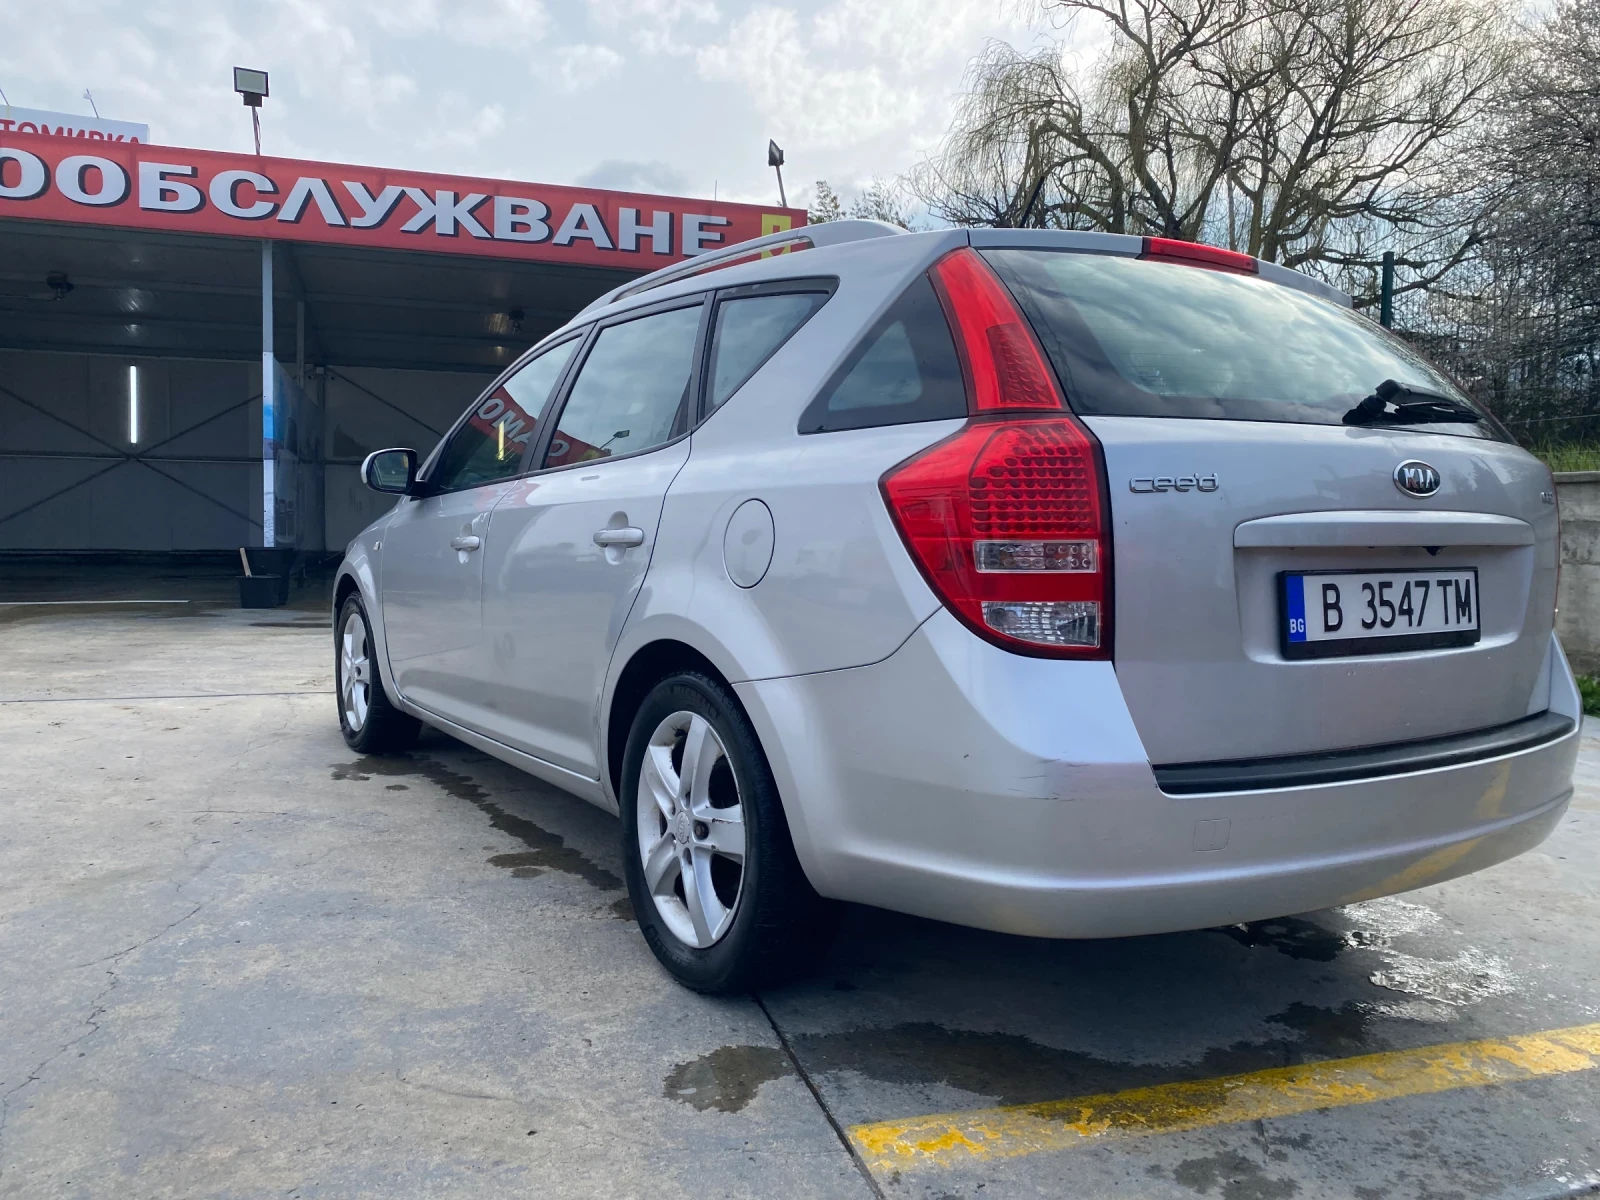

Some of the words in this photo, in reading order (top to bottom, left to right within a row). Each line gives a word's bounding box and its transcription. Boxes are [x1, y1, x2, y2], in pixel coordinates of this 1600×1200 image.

[1403, 467, 1437, 489] KIA
[1321, 583, 1343, 632] B
[1361, 580, 1430, 629] 3547
[1437, 579, 1472, 625] TM
[1289, 618, 1305, 633] BG
